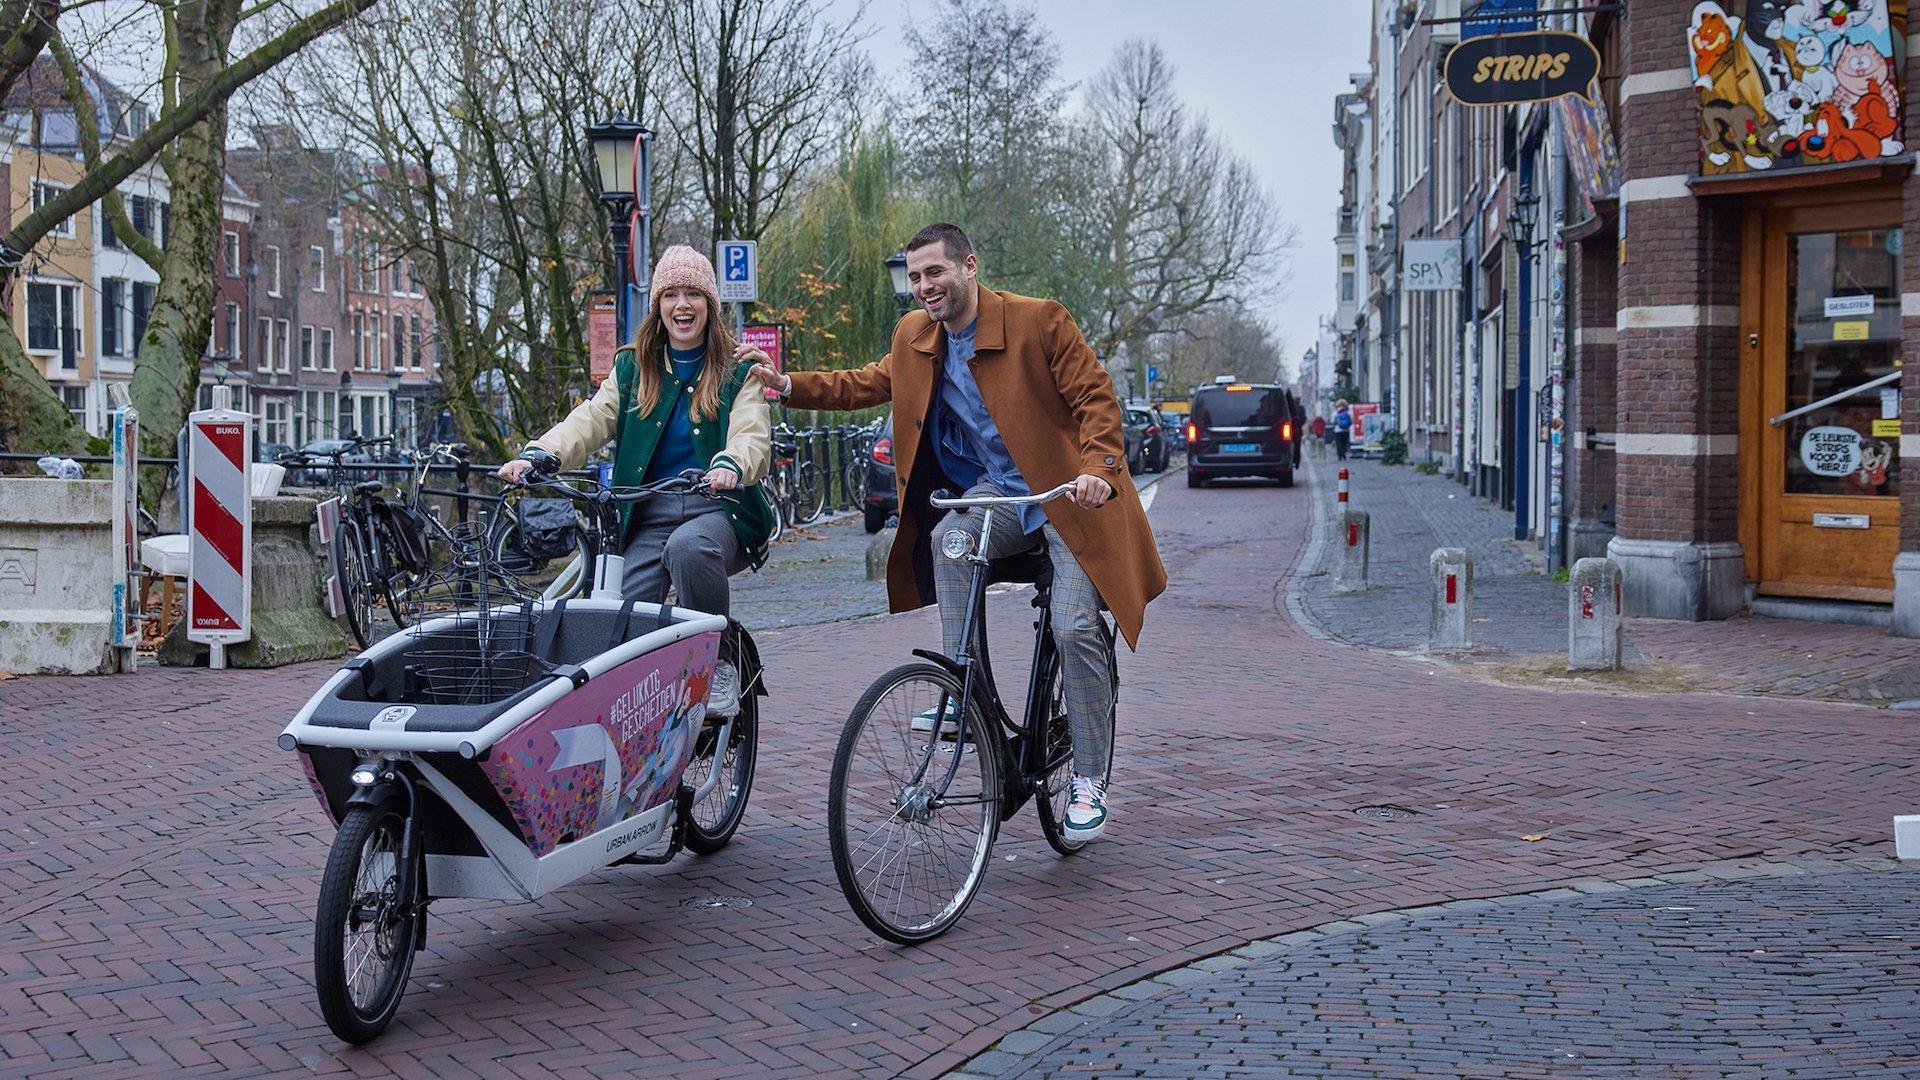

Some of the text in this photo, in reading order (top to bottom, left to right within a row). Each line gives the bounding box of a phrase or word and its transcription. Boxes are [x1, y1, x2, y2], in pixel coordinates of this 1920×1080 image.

[1472, 51, 1571, 84] STRIPS
[729, 247, 744, 268] P
[1410, 262, 1443, 279] SPA
[215, 427, 241, 435] BUKO.
[1809, 432, 1858, 444] DE LEUKSTE
[1809, 452, 1852, 463] KOOP JE
[1817, 462, 1840, 472] HIER
[610, 668, 661, 726] #GELUKKIG
[621, 681, 677, 744] GESCHEIDEN
[606, 831, 633, 853] URBAN
